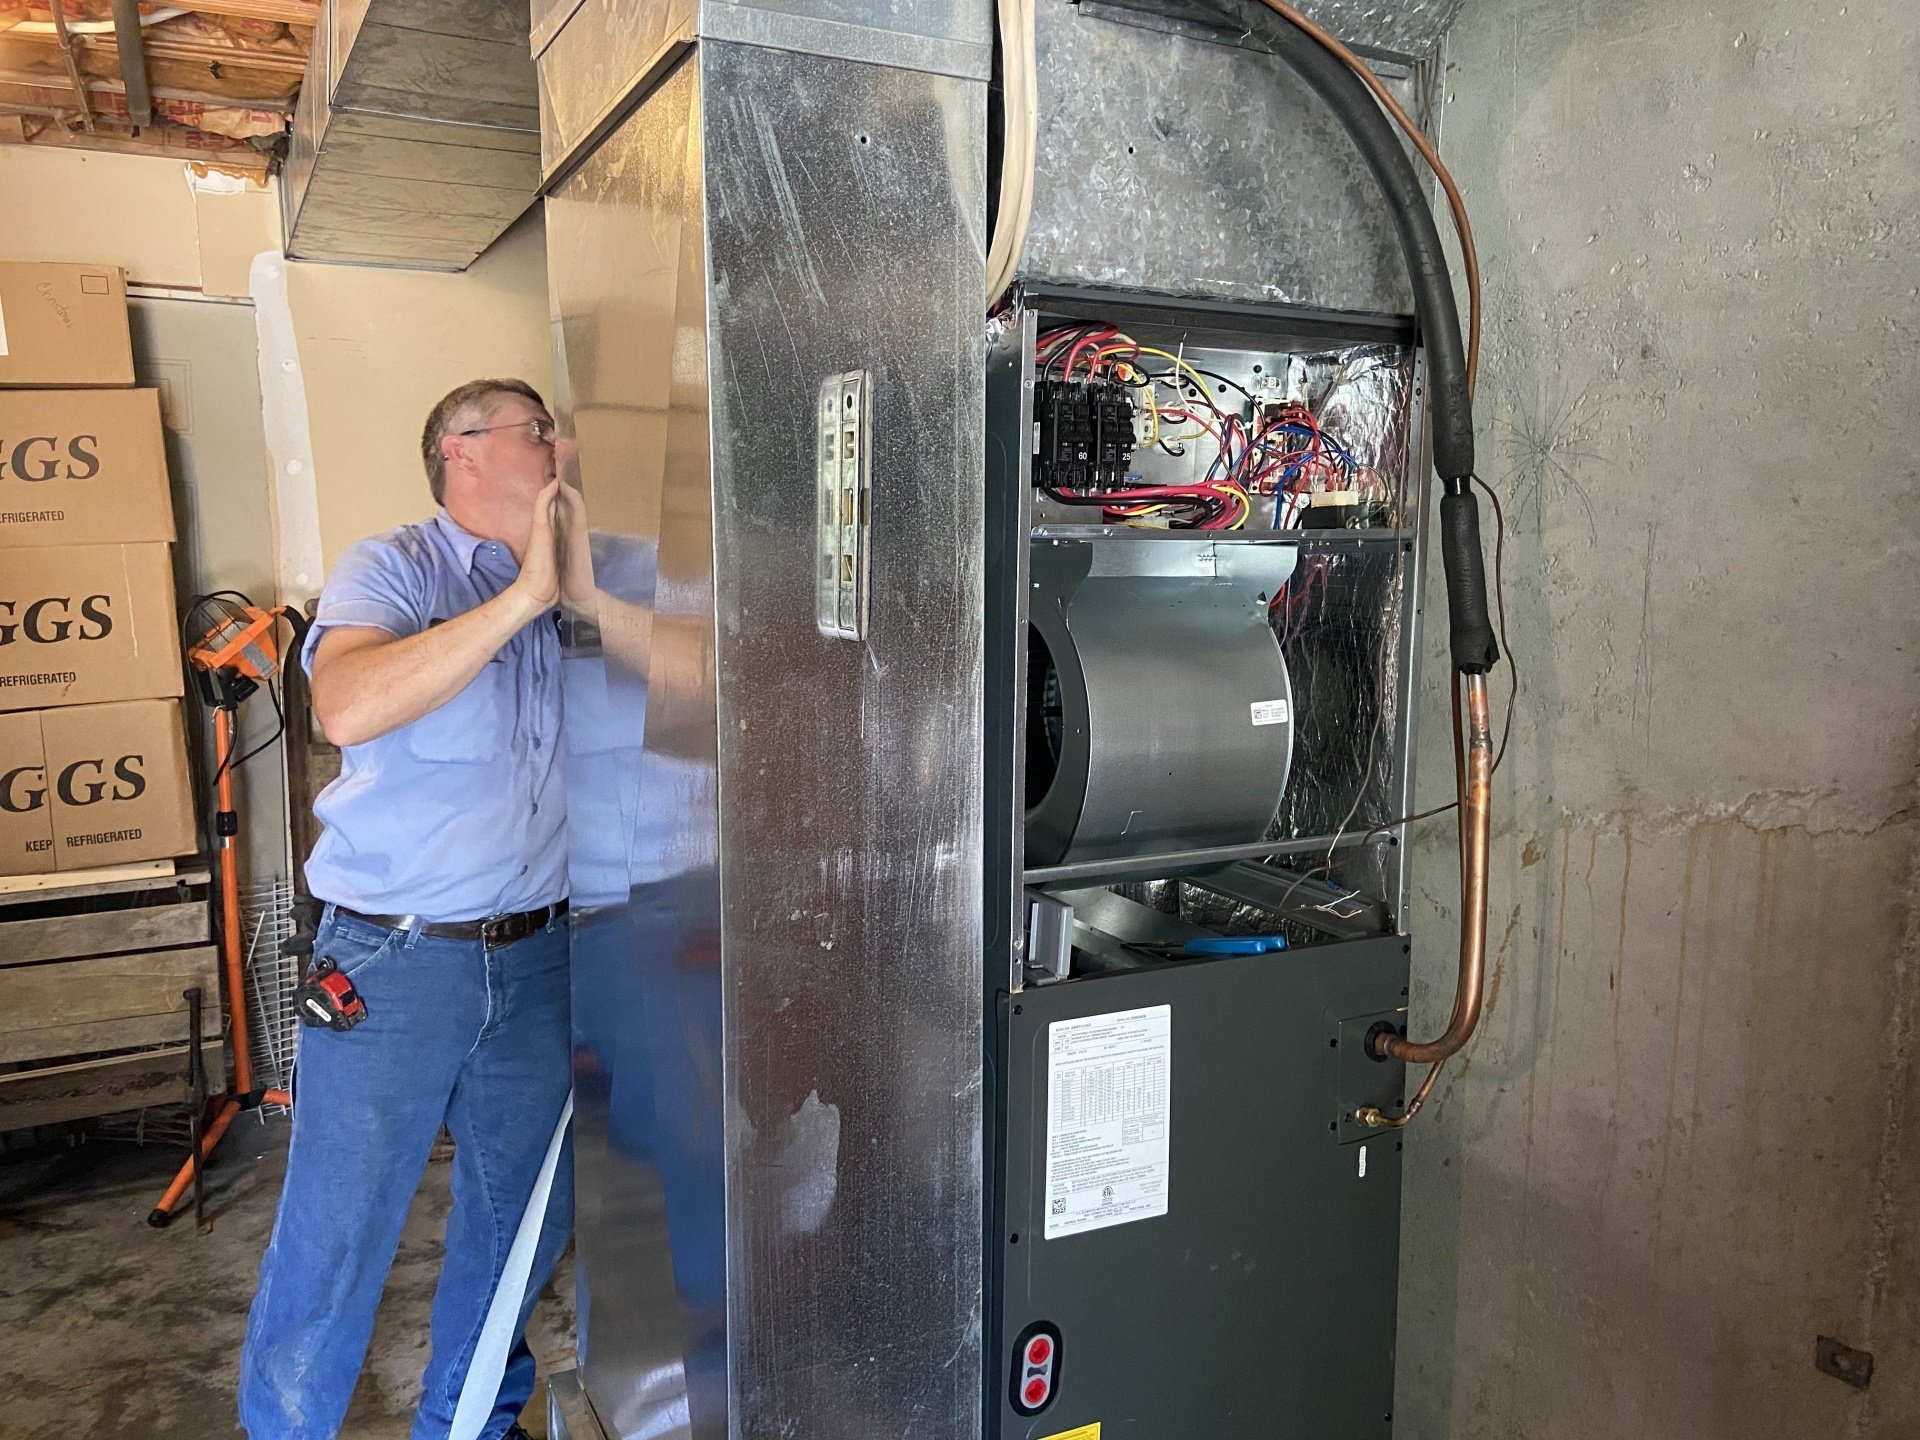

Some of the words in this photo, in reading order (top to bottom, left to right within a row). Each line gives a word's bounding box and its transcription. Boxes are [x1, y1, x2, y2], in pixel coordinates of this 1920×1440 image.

[0, 434, 100, 482] GS
[1078, 452, 1087, 460] 60
[1122, 452, 1131, 461] 25
[0, 510, 65, 524] FRIGERATED
[0, 671, 76, 687] REFRIGERATED
[0, 755, 146, 813] GGS
[25, 839, 53, 852] KEEP
[66, 828, 143, 848] REFRIGERATED
